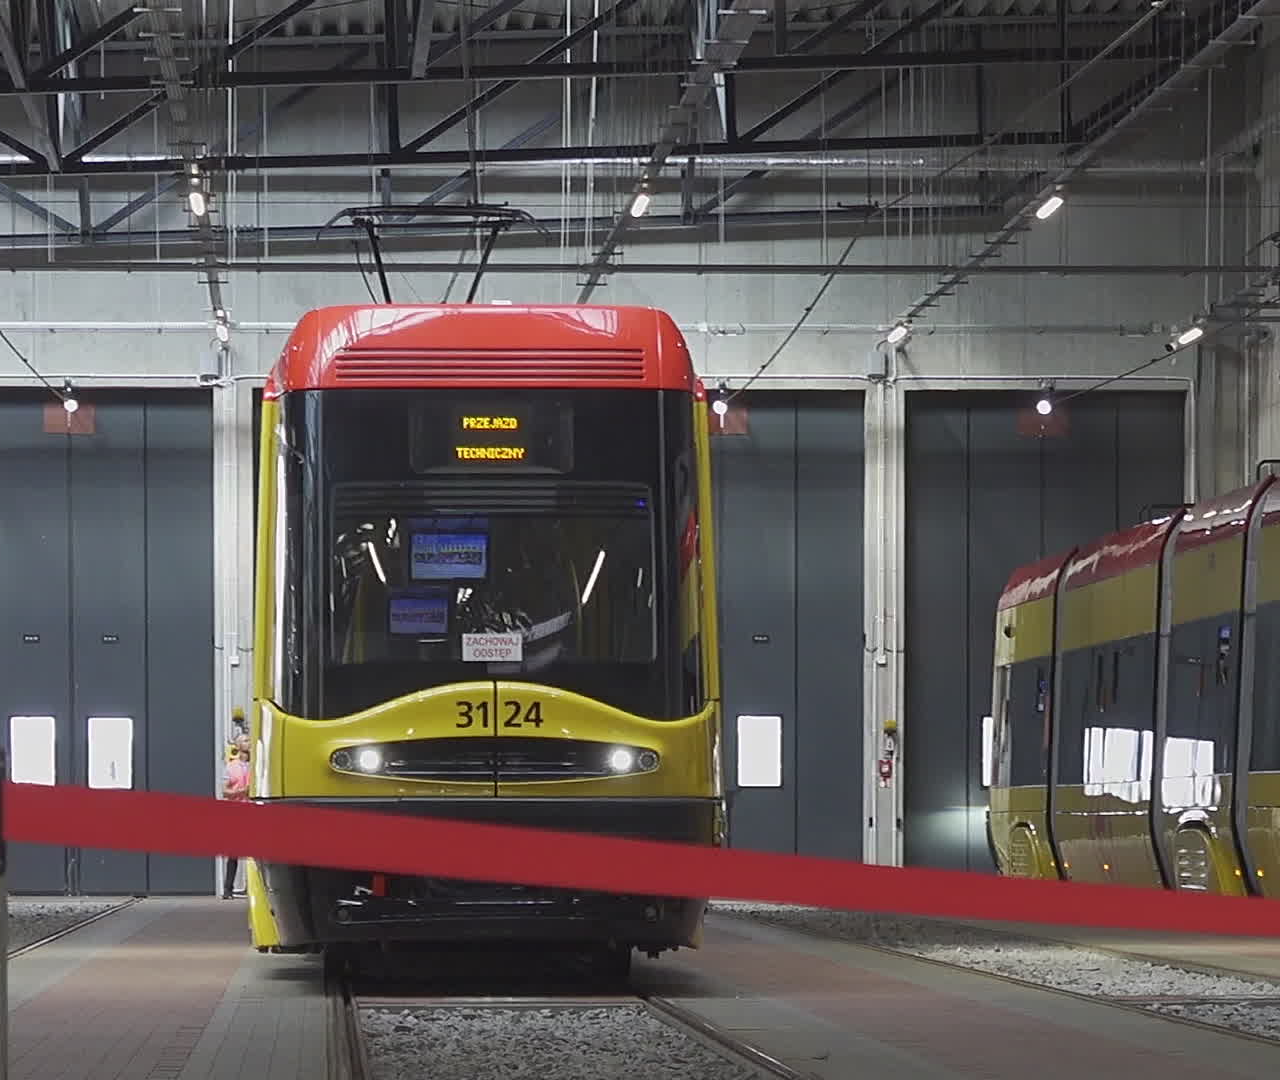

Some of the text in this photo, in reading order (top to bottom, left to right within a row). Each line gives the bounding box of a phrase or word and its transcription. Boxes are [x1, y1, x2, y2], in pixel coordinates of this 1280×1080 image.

[462, 416, 518, 430] PRZEJAZD
[455, 446, 525, 460] TECHNICZNY
[464, 636, 520, 647] ZACHOWAJ
